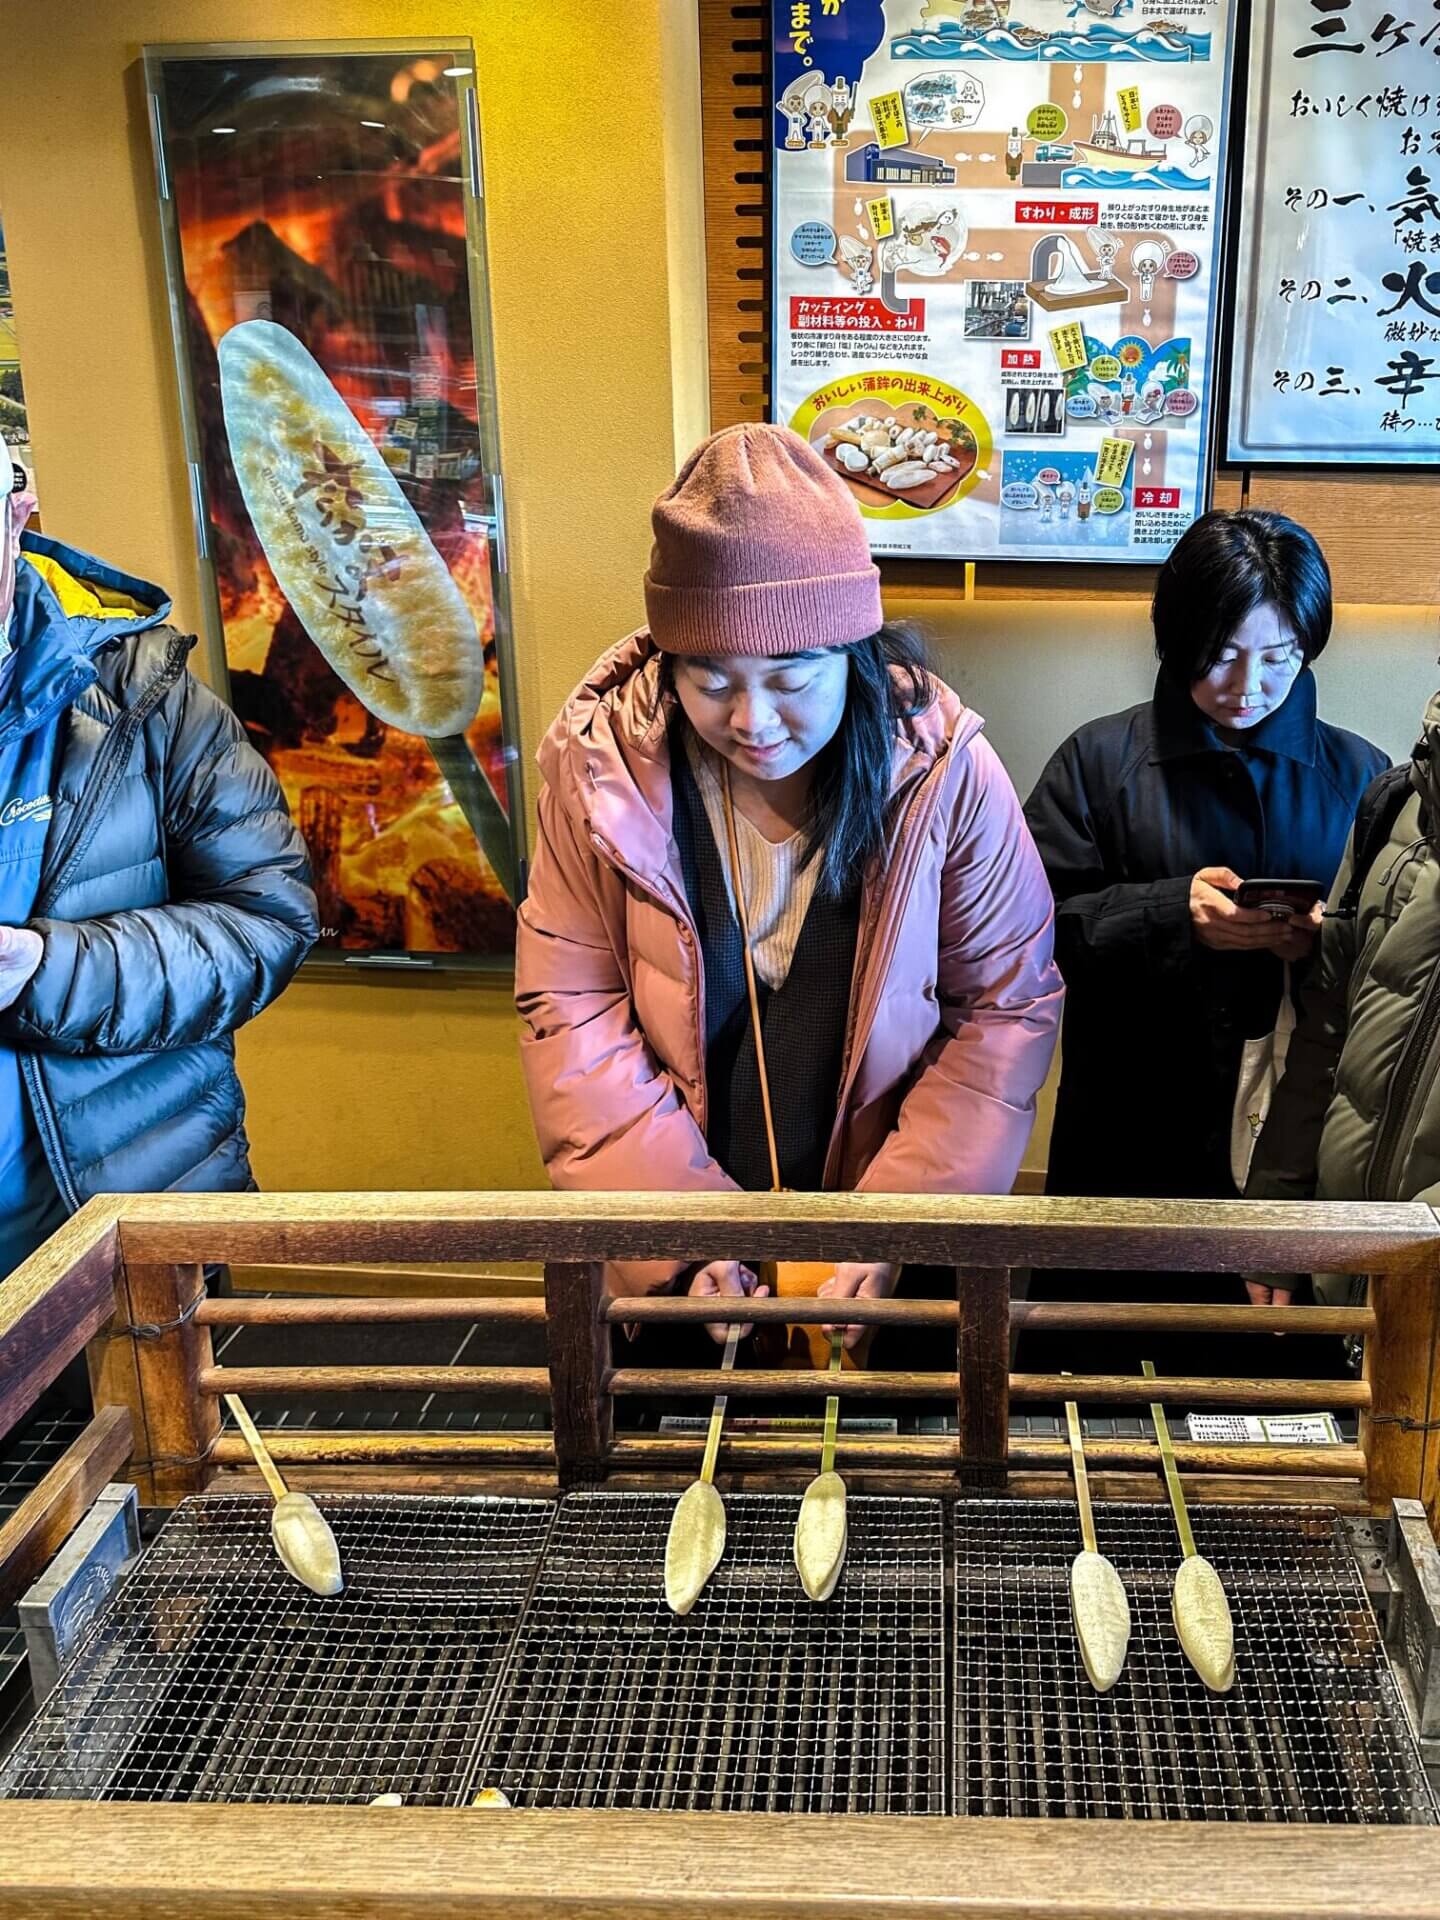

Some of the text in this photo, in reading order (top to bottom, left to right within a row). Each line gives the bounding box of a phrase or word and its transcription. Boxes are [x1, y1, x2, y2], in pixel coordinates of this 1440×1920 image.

[789, 2, 814, 67] まで。
[1290, 85, 1440, 118] おいしく焼け
[1285, 187, 1375, 213] その一、
[1020, 205, 1095, 222] すわり・成形
[1101, 213, 1209, 222] りやすくなるまで寝かせ、すり身生
[1280, 261, 1440, 318] その二、 火
[798, 301, 875, 314] カッティング・
[797, 315, 918, 330] 副材料等の投入・ねり
[1272, 351, 1440, 410] その三、 辛
[812, 376, 969, 415] おいしい蒲鉾の出来上がり
[1141, 491, 1173, 504] 冷却
[1134, 519, 1186, 527] 閉じ込めるために
[1135, 511, 1192, 519] おいしさをぎゅっと
[304, 541, 330, 576] style
[315, 575, 396, 683] スタイル
